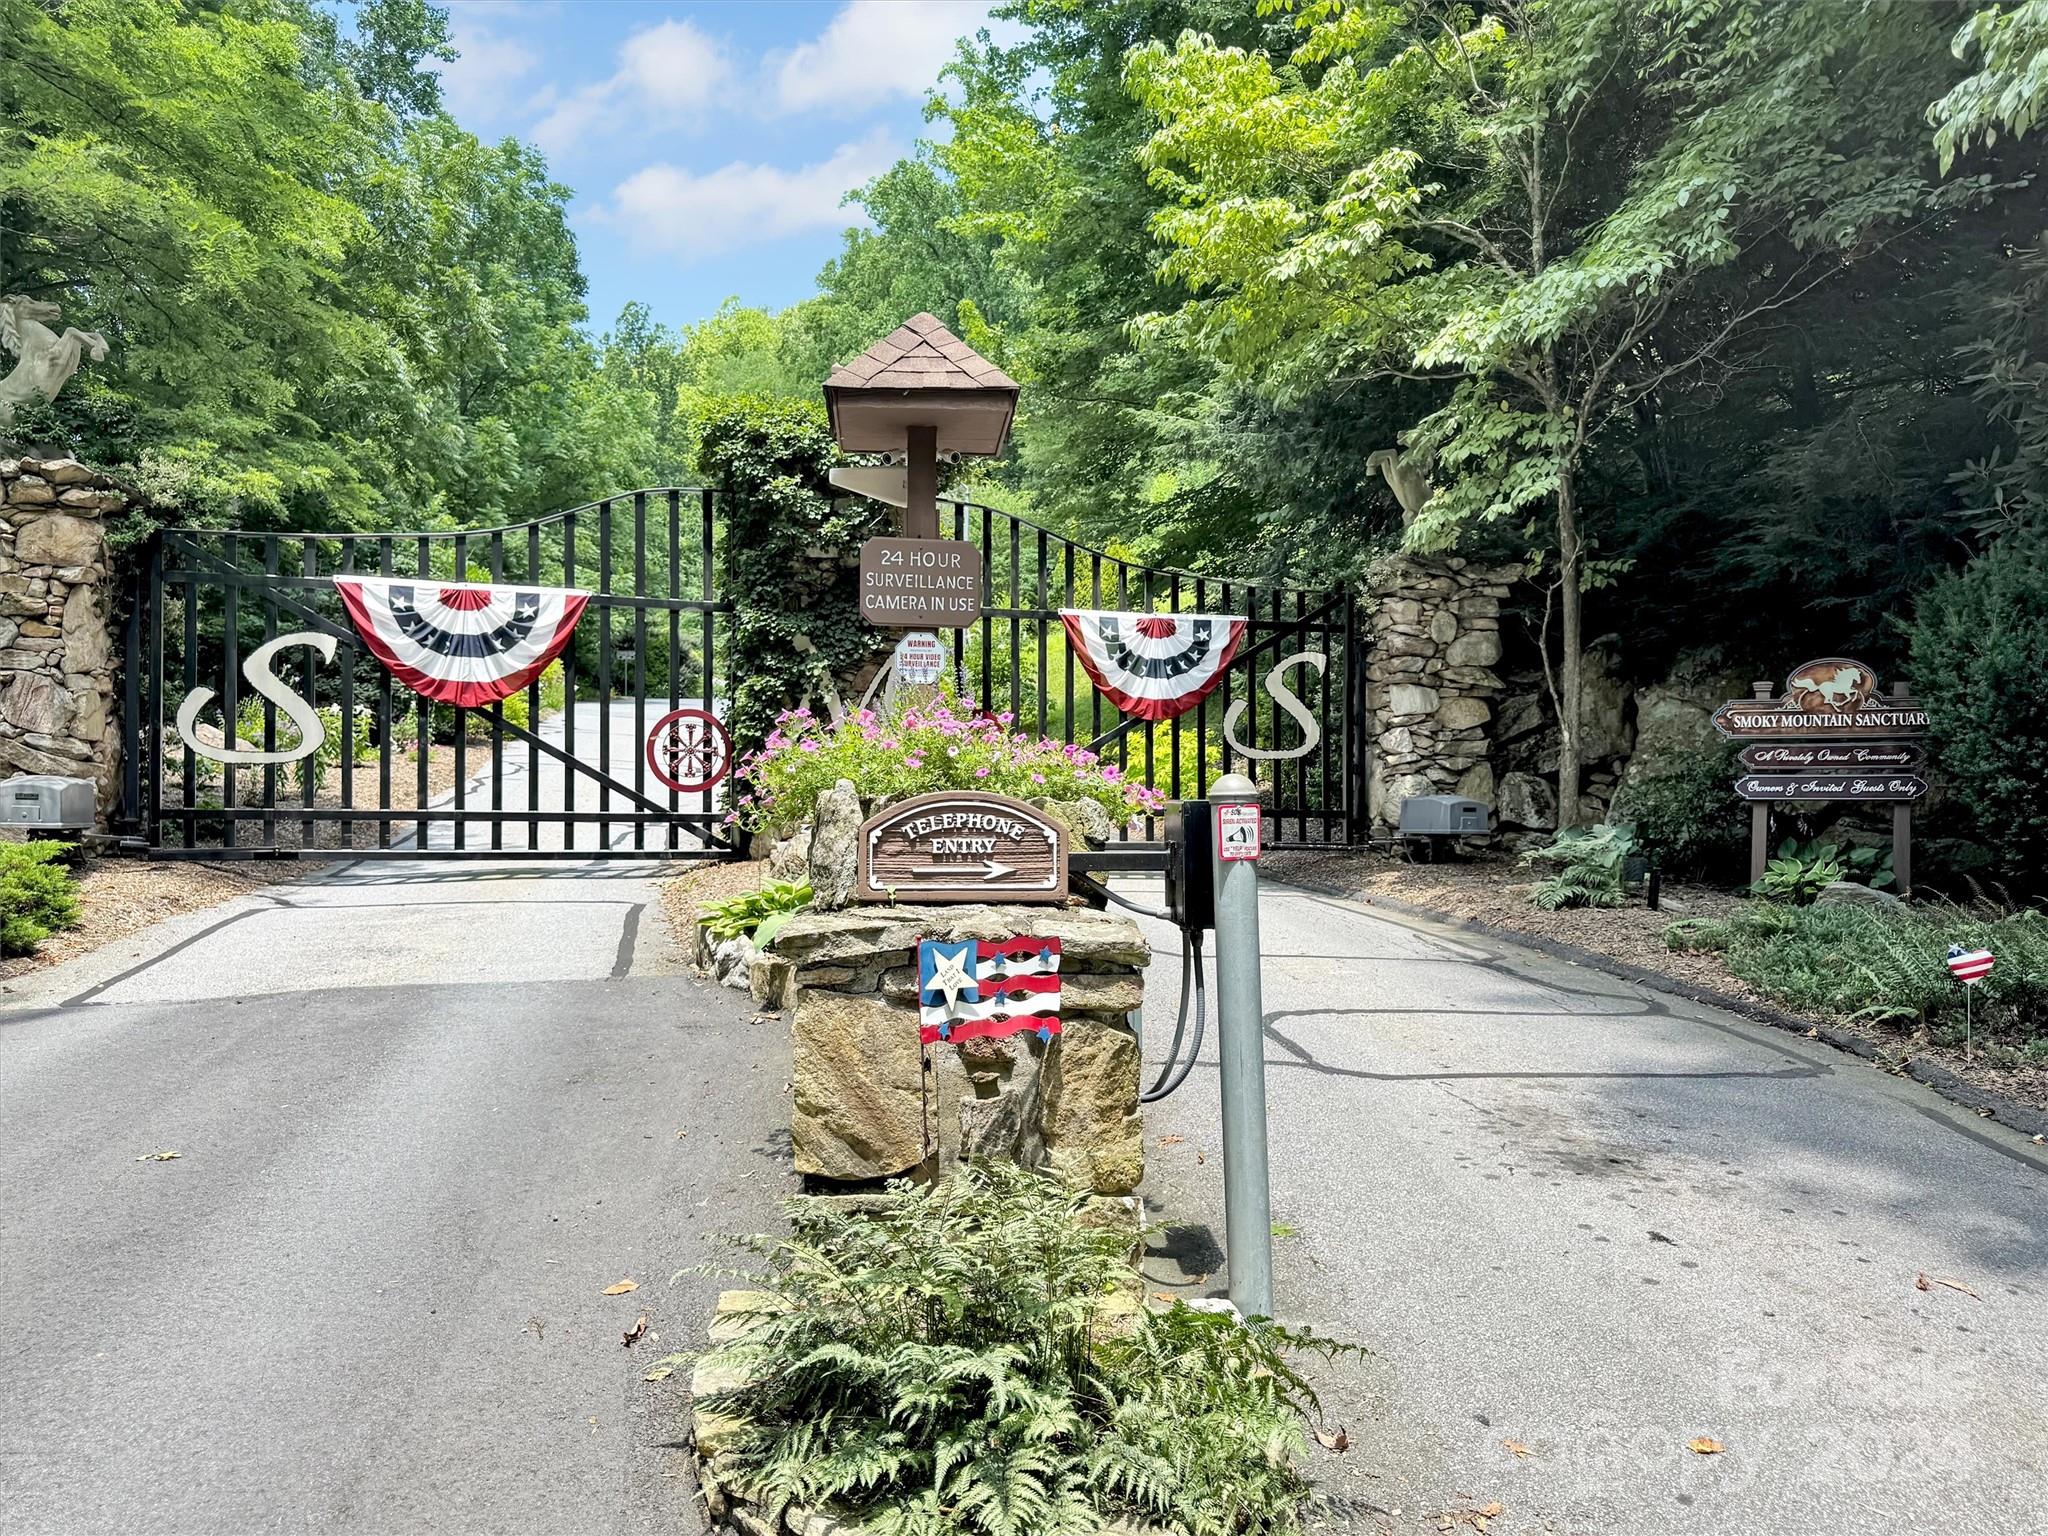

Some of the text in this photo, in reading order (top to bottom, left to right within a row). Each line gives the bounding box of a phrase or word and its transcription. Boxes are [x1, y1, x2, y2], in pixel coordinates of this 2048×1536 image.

[881, 550, 961, 568] 24 HOUR
[866, 572, 974, 590] SURVEILLANCE
[865, 594, 975, 612] CAMERA IN USE
[907, 640, 936, 648] WARNING
[177, 632, 338, 764] S
[1223, 652, 1327, 759] S
[1733, 715, 1779, 728] SMOKY
[1781, 714, 1852, 727] MOUNTAIN
[1754, 749, 1911, 764] A Privately Owned Community
[1747, 779, 1917, 795] Owners & Invited Guests Only
[901, 813, 1027, 841] TELEPHONE
[931, 838, 998, 854] ENTRY
